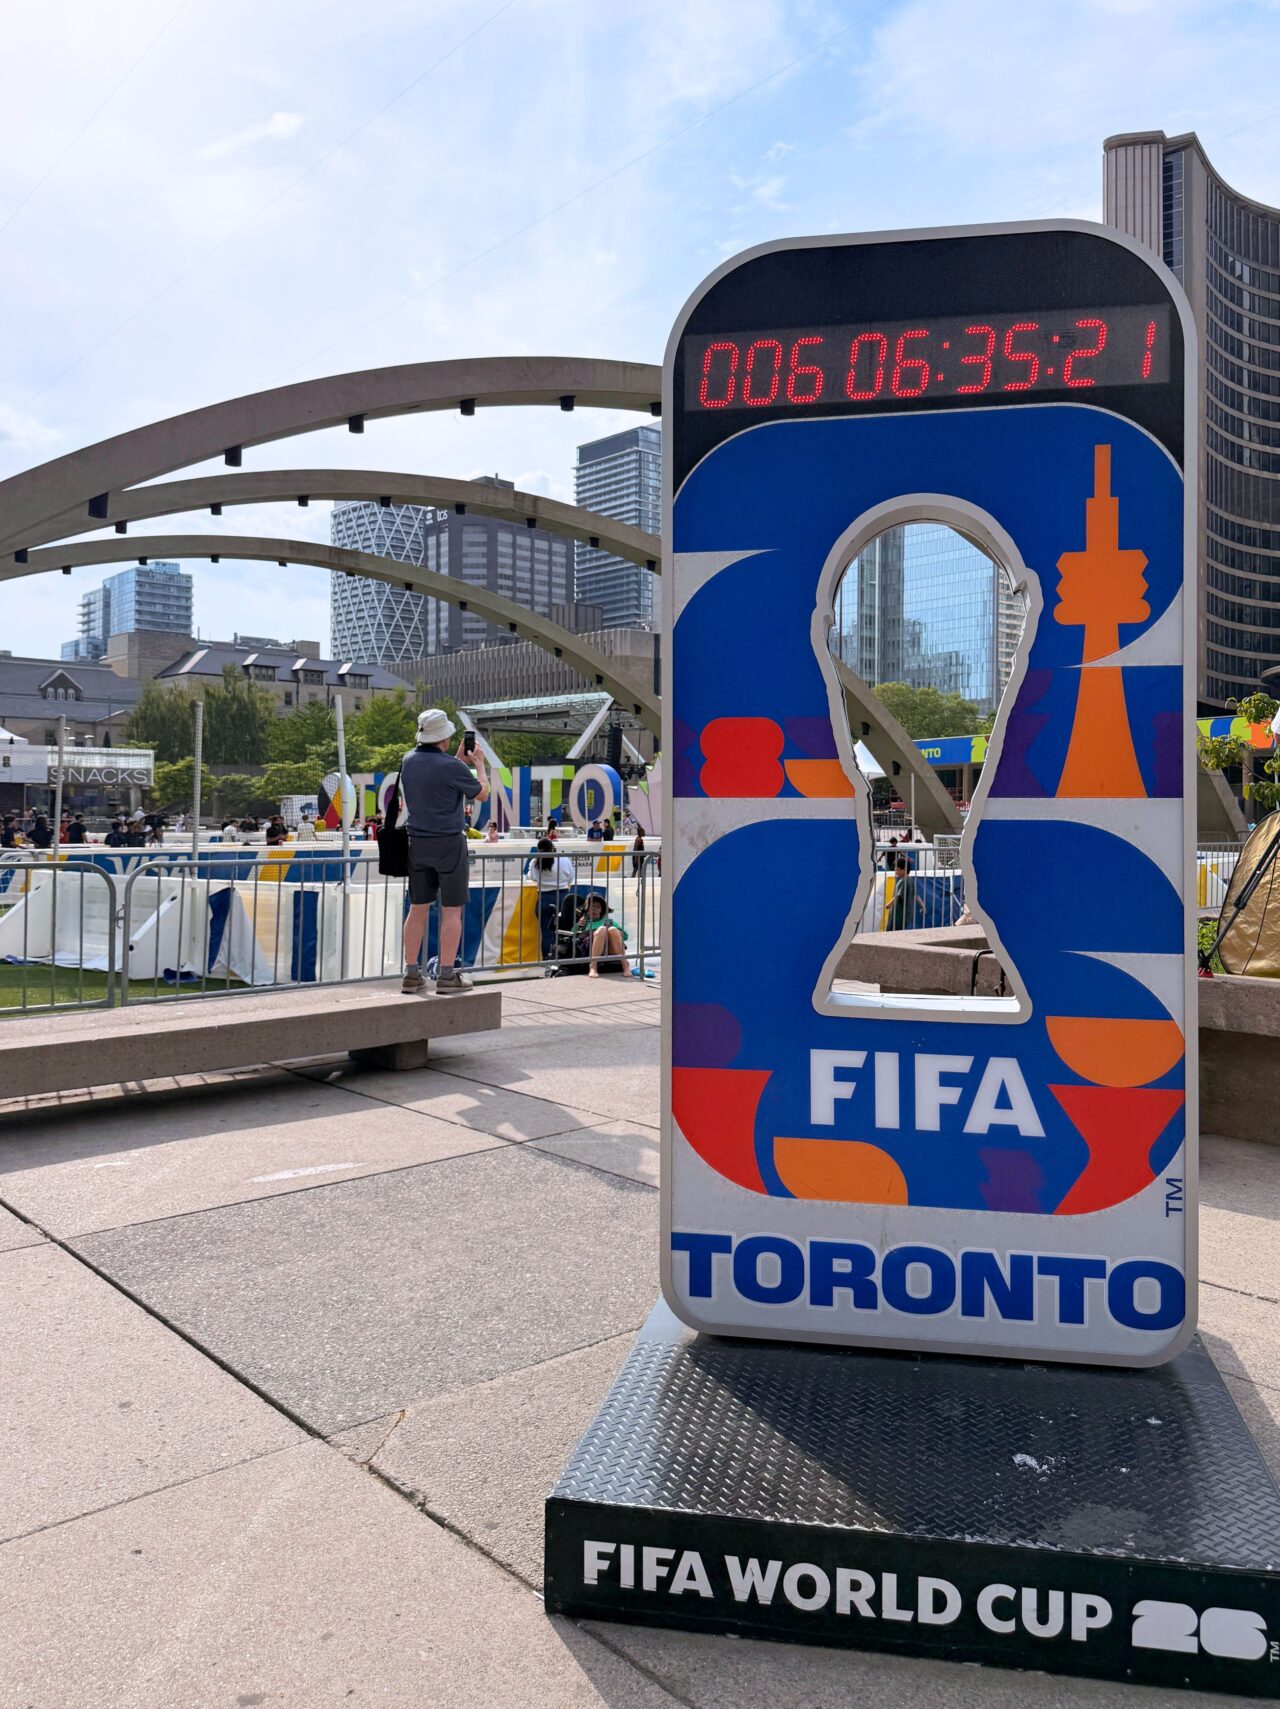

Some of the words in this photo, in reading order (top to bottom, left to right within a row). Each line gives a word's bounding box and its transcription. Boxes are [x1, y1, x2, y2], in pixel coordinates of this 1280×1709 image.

[699, 337, 824, 408] 006
[49, 767, 148, 784] SNACKS
[810, 1048, 1047, 1138] FIFA
[671, 1231, 1186, 1332] TORONTO
[583, 1540, 715, 1599] FIFA
[724, 1554, 962, 1626] WORLD
[976, 1583, 1113, 1642] CUP
[1131, 1600, 1268, 1661] 26
